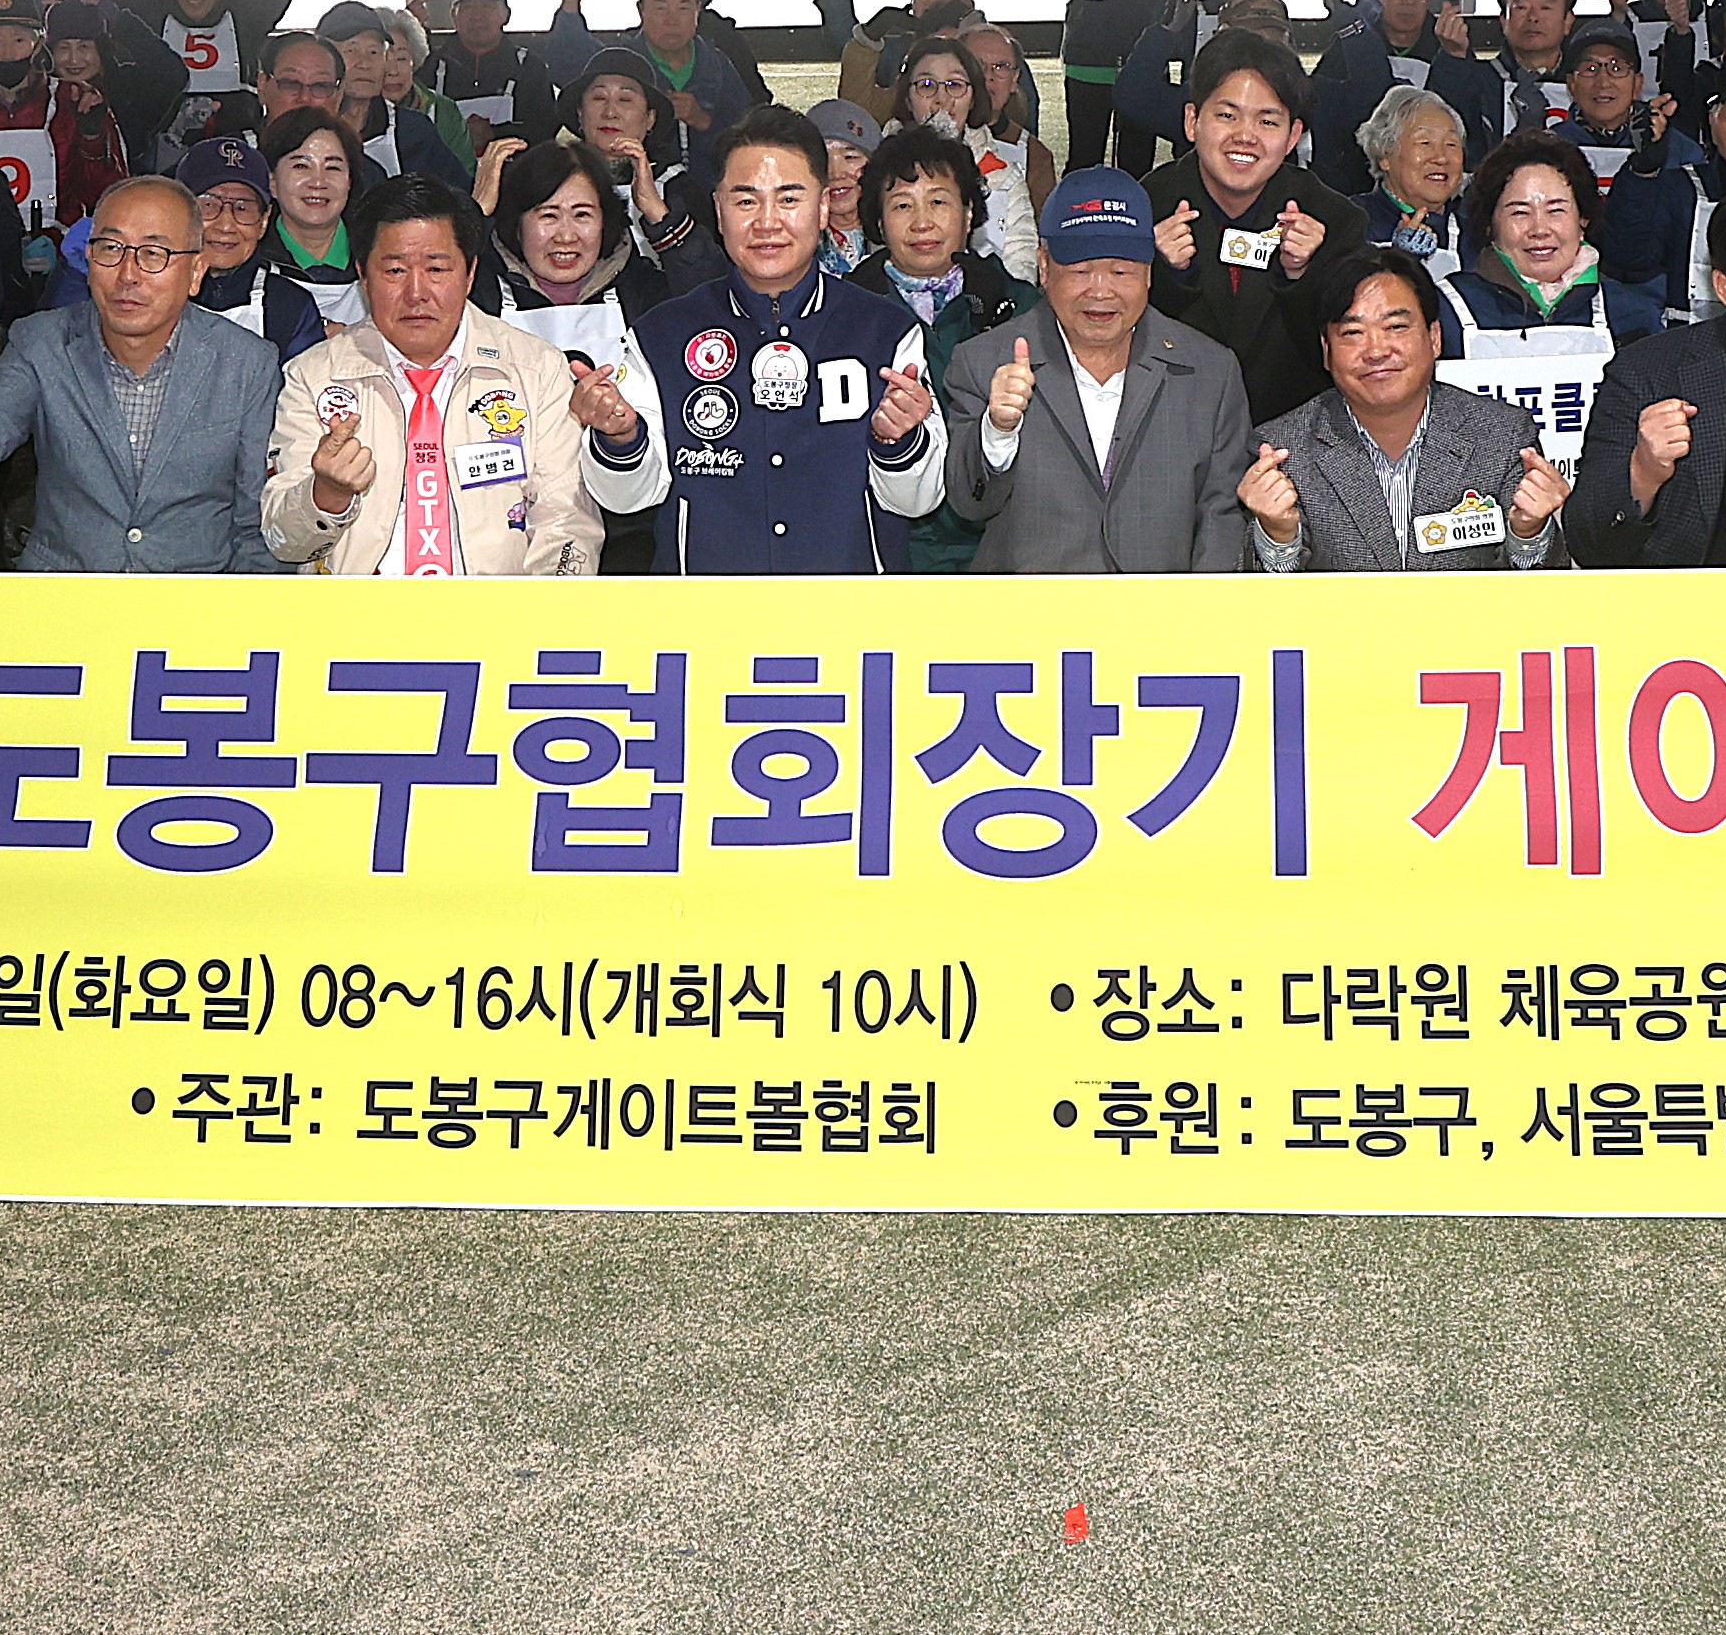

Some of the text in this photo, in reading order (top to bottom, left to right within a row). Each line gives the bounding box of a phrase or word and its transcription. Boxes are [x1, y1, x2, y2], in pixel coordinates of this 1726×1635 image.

[184, 33, 219, 70] 5
[817, 358, 870, 423] D
[413, 442, 440, 451] SEOUL
[1453, 522, 1497, 541] 이성민
[301, 959, 786, 1039] 08~16시(개회식
[822, 961, 977, 1043] 10시)
[1093, 966, 1243, 1042] 장소:
[1282, 964, 1470, 1041] 다락원
[172, 1072, 936, 1154] 주관: 도봉구게이트볼협회
[1285, 1084, 1494, 1161] 도봉구,
